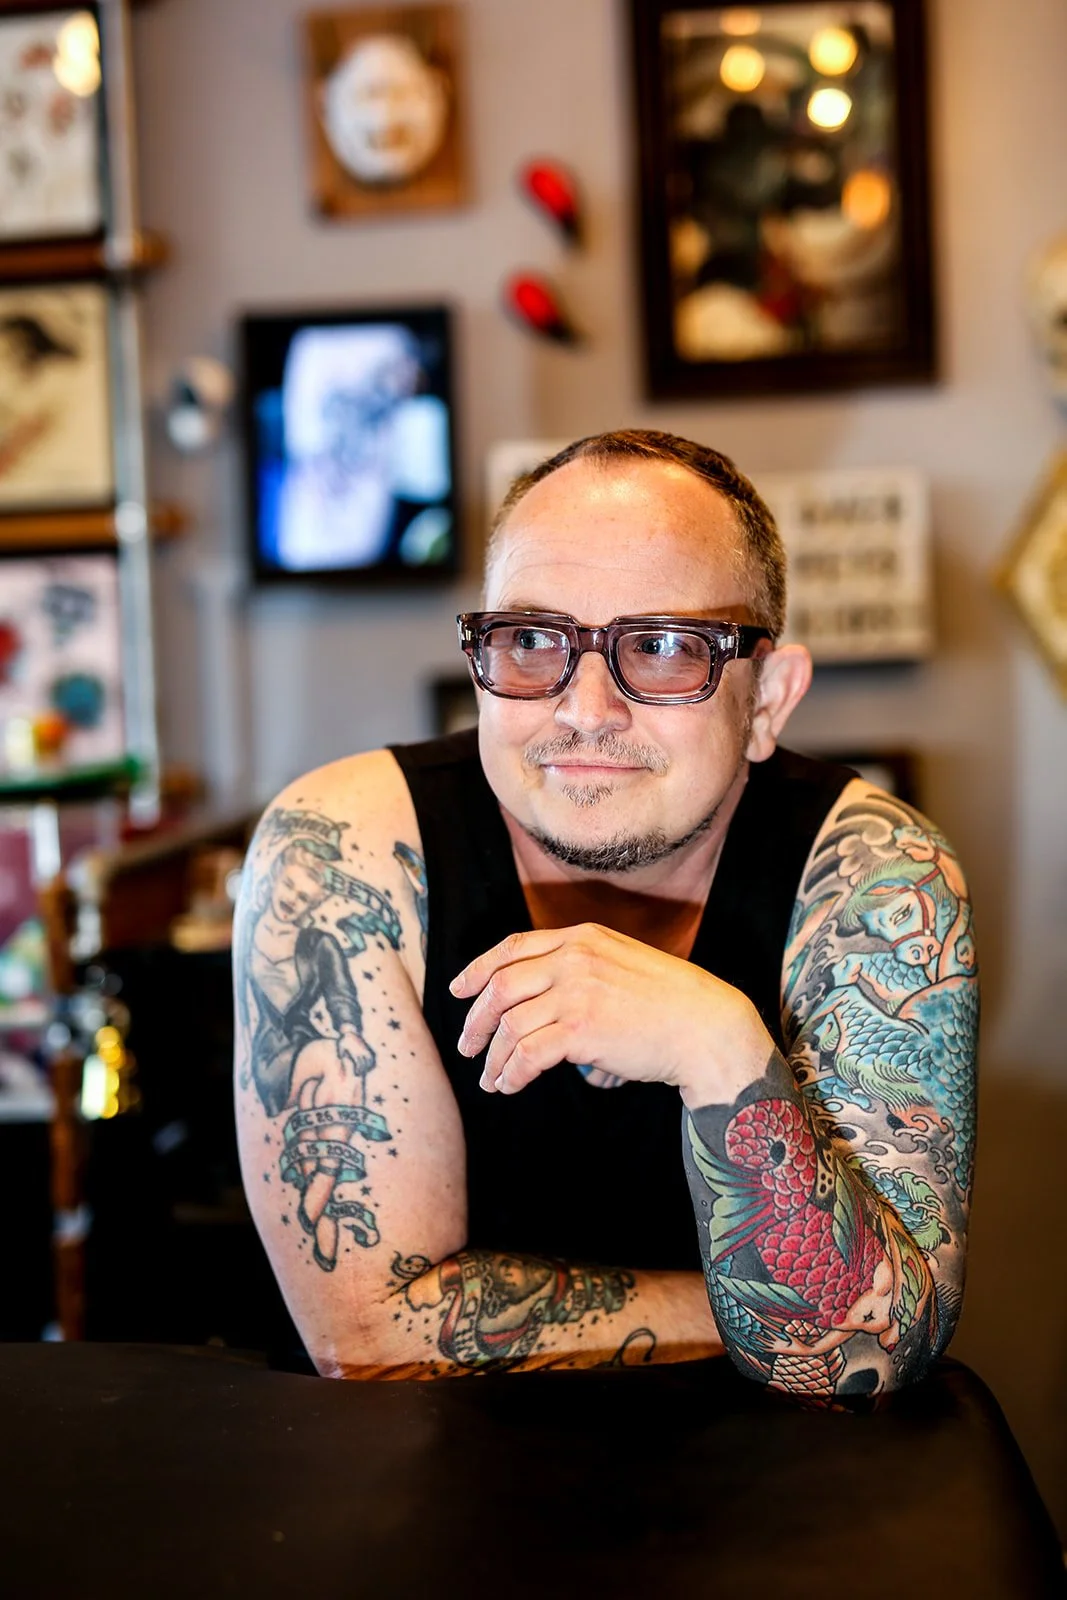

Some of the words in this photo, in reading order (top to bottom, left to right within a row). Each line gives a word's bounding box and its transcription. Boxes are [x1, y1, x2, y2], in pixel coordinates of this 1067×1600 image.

[291, 1113, 315, 1132] DEC
[316, 1110, 333, 1123] 26
[306, 1143, 319, 1155] 15
[326, 1144, 361, 1164] 2006
